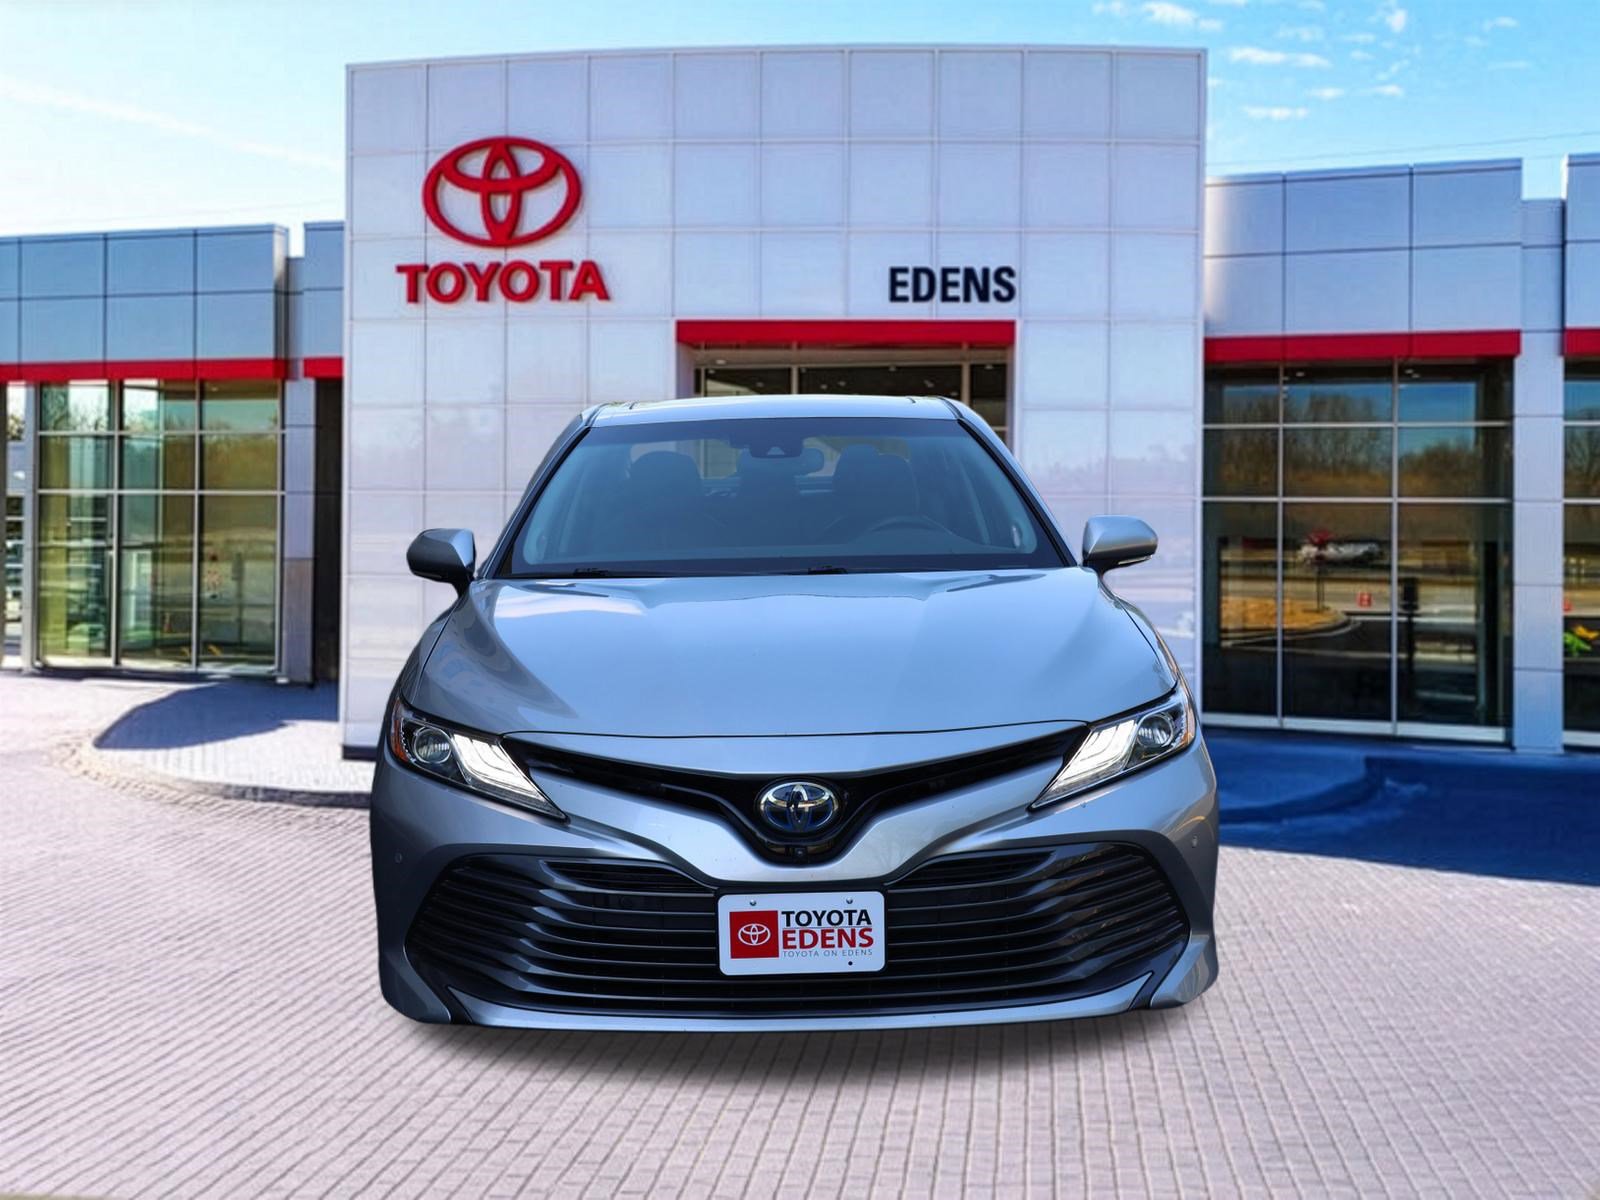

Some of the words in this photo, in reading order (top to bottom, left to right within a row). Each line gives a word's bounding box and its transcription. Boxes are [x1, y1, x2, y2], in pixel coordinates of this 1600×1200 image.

[396, 260, 611, 304] TOYOTA
[889, 266, 1016, 303] EDENS
[781, 909, 872, 927] TOYOTA
[782, 927, 874, 949] EDENS
[783, 950, 819, 958] TOYOTA
[823, 949, 838, 957] ON
[842, 948, 873, 957] EDENS
